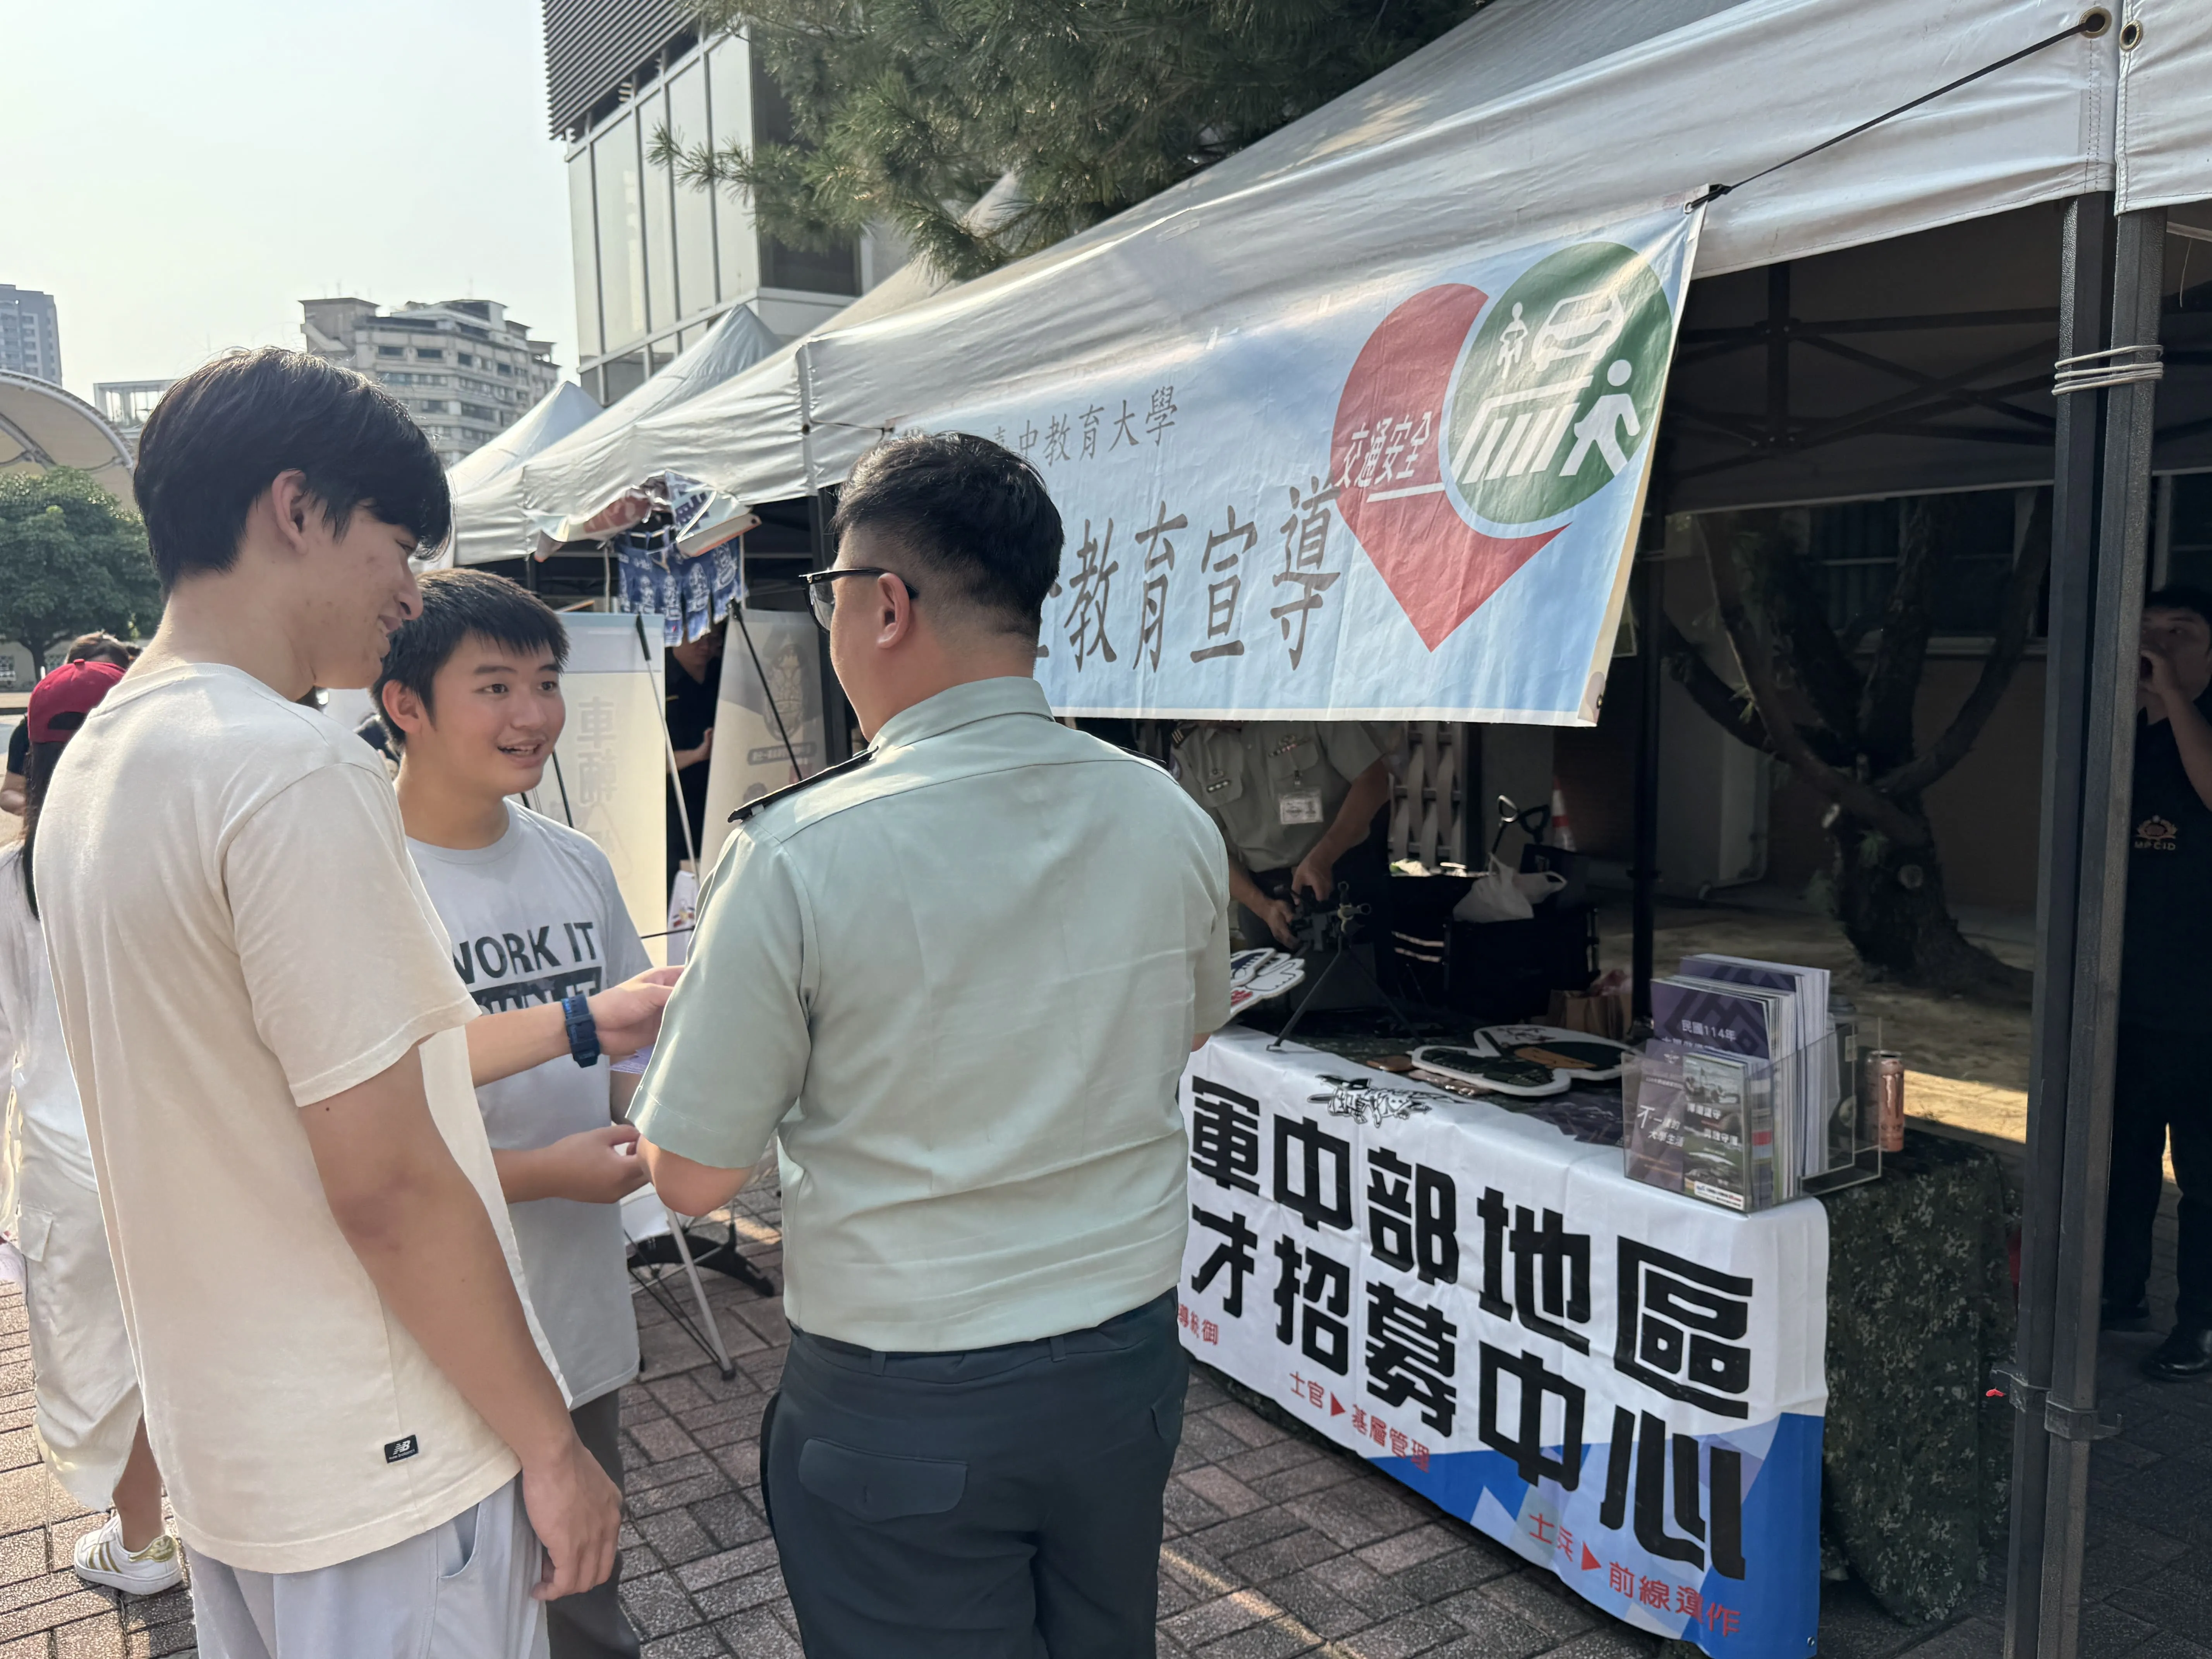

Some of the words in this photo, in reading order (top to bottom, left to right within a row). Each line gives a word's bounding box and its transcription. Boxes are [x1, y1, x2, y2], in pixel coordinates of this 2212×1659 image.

[1334, 410, 1432, 489] 交通安全
[1035, 476, 1341, 673] 教育宣導
[564, 922, 596, 963] IT
[1681, 1019, 1736, 1042] 民國114年
[1190, 1075, 1753, 1419] 軍中部地區
[1190, 1204, 1746, 1580] 才招募中心
[1290, 1371, 1325, 1409] 士官
[1352, 1403, 1430, 1473] 基層管理
[1609, 1561, 1741, 1637] 前線運作
